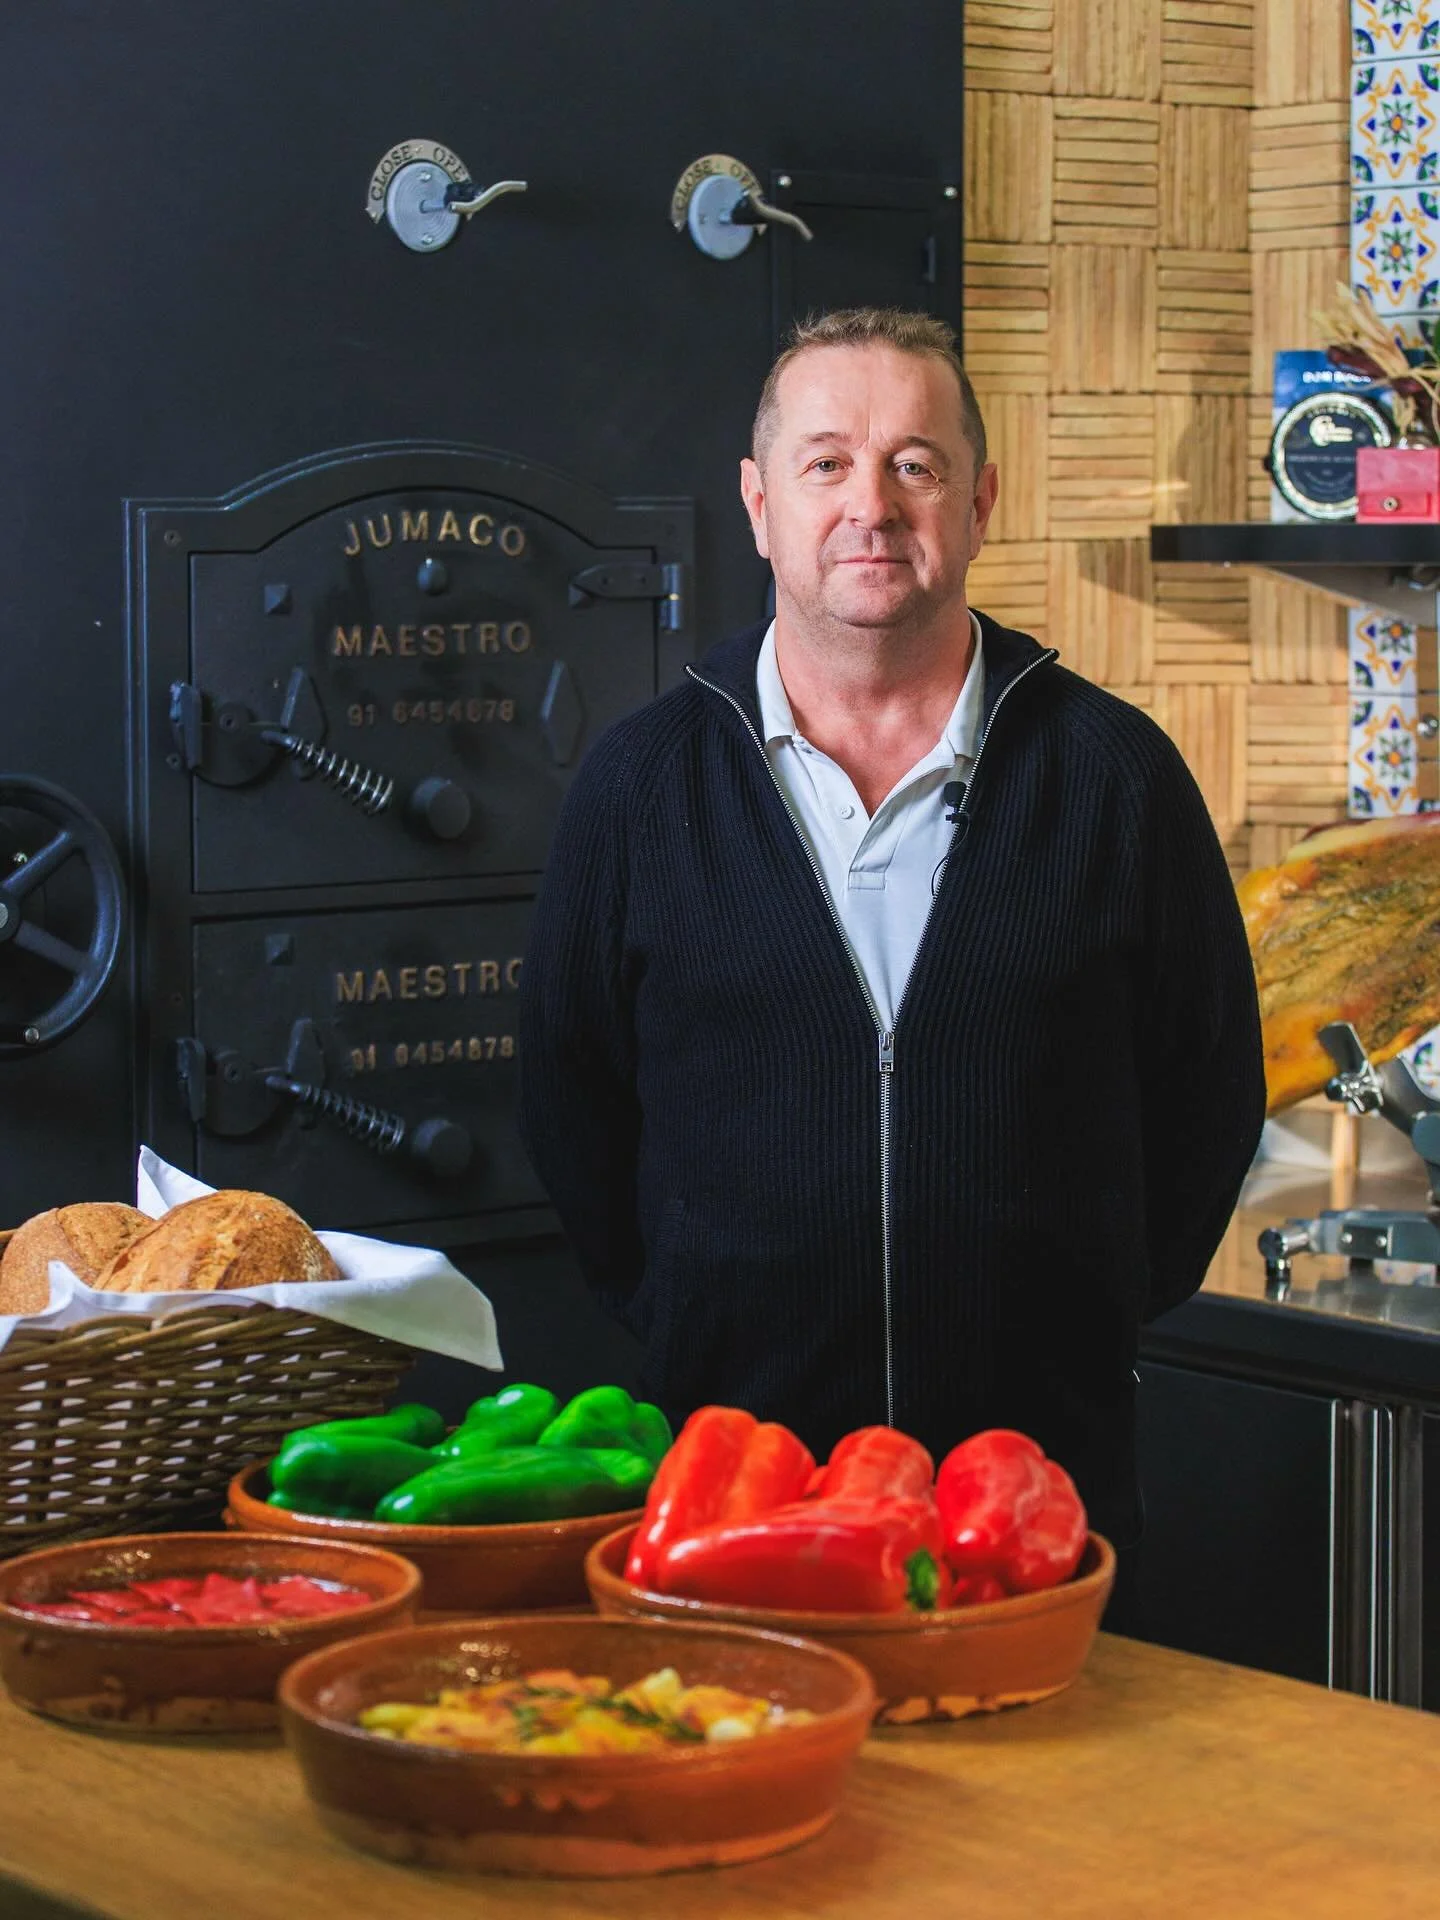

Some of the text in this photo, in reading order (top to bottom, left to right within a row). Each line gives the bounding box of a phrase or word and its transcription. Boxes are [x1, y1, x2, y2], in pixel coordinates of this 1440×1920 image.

[371, 144, 468, 201] CLOSE OPE
[675, 159, 712, 210] CLOSE
[344, 510, 526, 557] JUMACO
[333, 621, 533, 657] MAESTRO
[347, 703, 376, 727] 91
